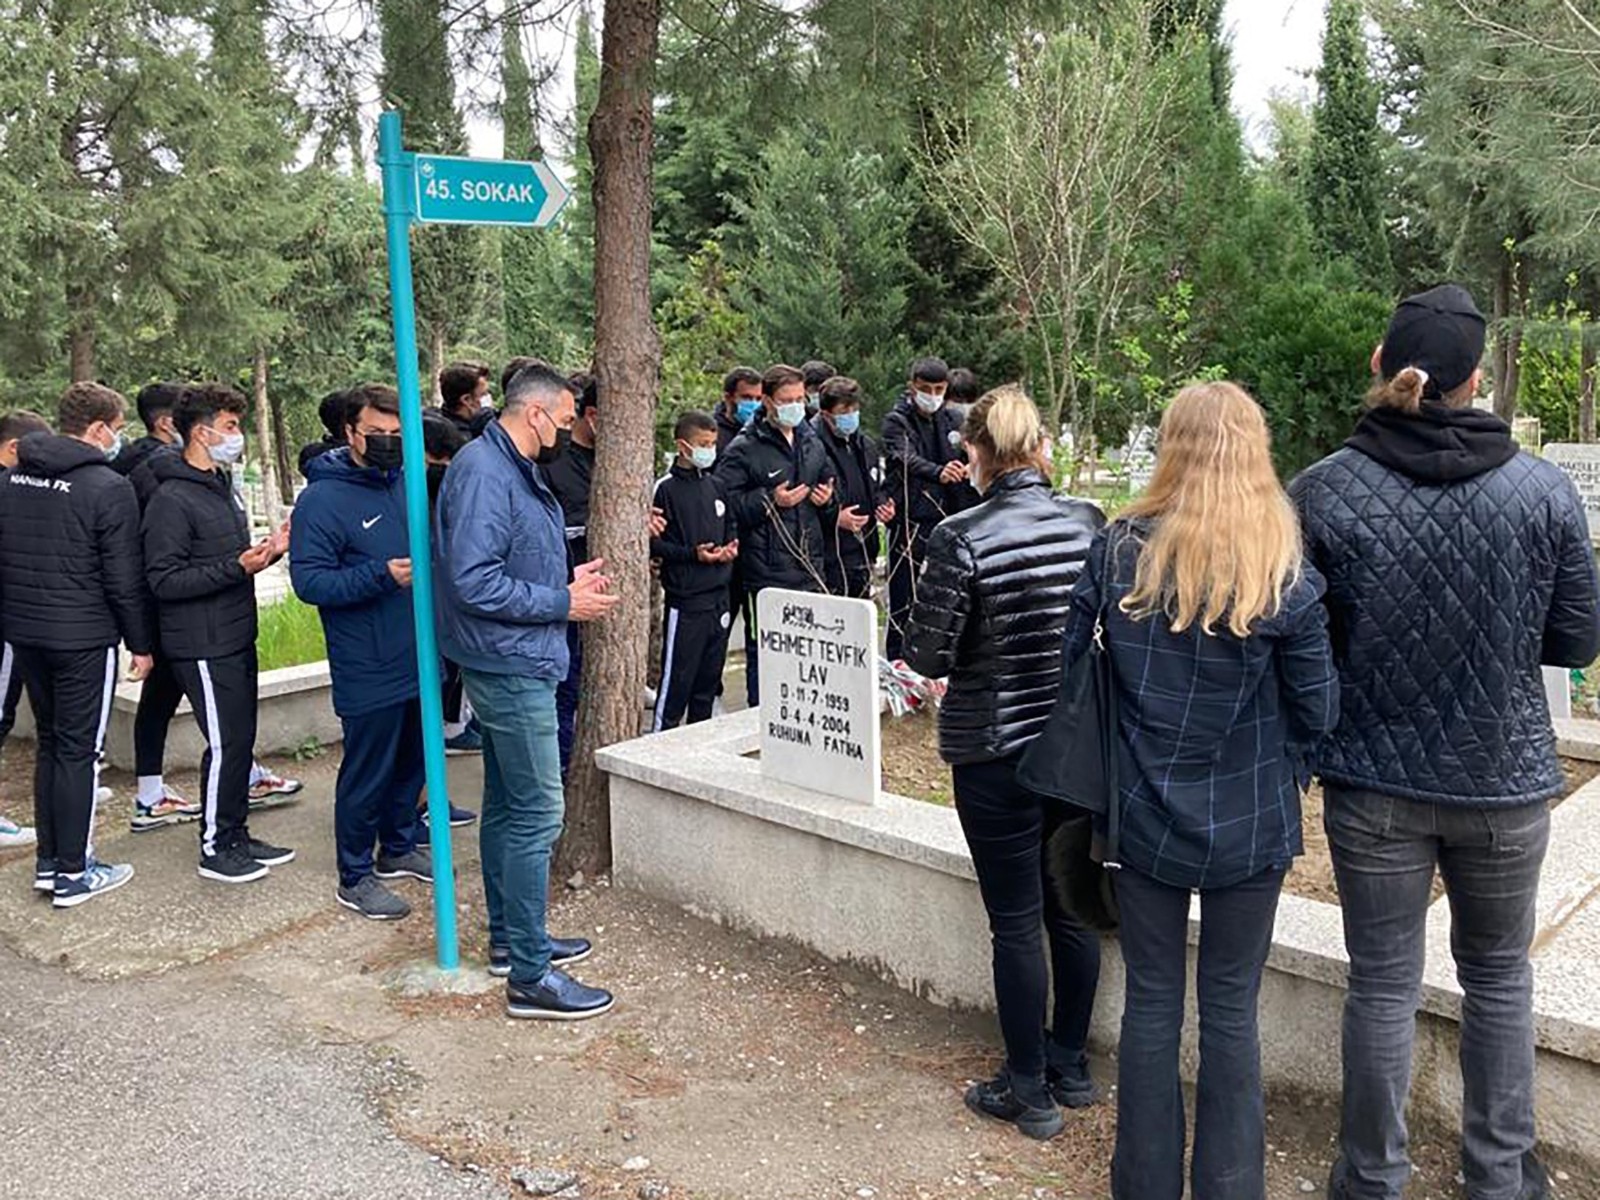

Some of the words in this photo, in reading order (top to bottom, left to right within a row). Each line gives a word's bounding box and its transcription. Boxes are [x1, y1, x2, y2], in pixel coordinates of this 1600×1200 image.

[425, 178, 456, 200] 45.
[461, 179, 534, 203] SOKAK
[52, 479, 72, 493] FK
[760, 628, 814, 657] MEHMET
[798, 661, 828, 687] LAV
[768, 721, 812, 746] RUHUNA
